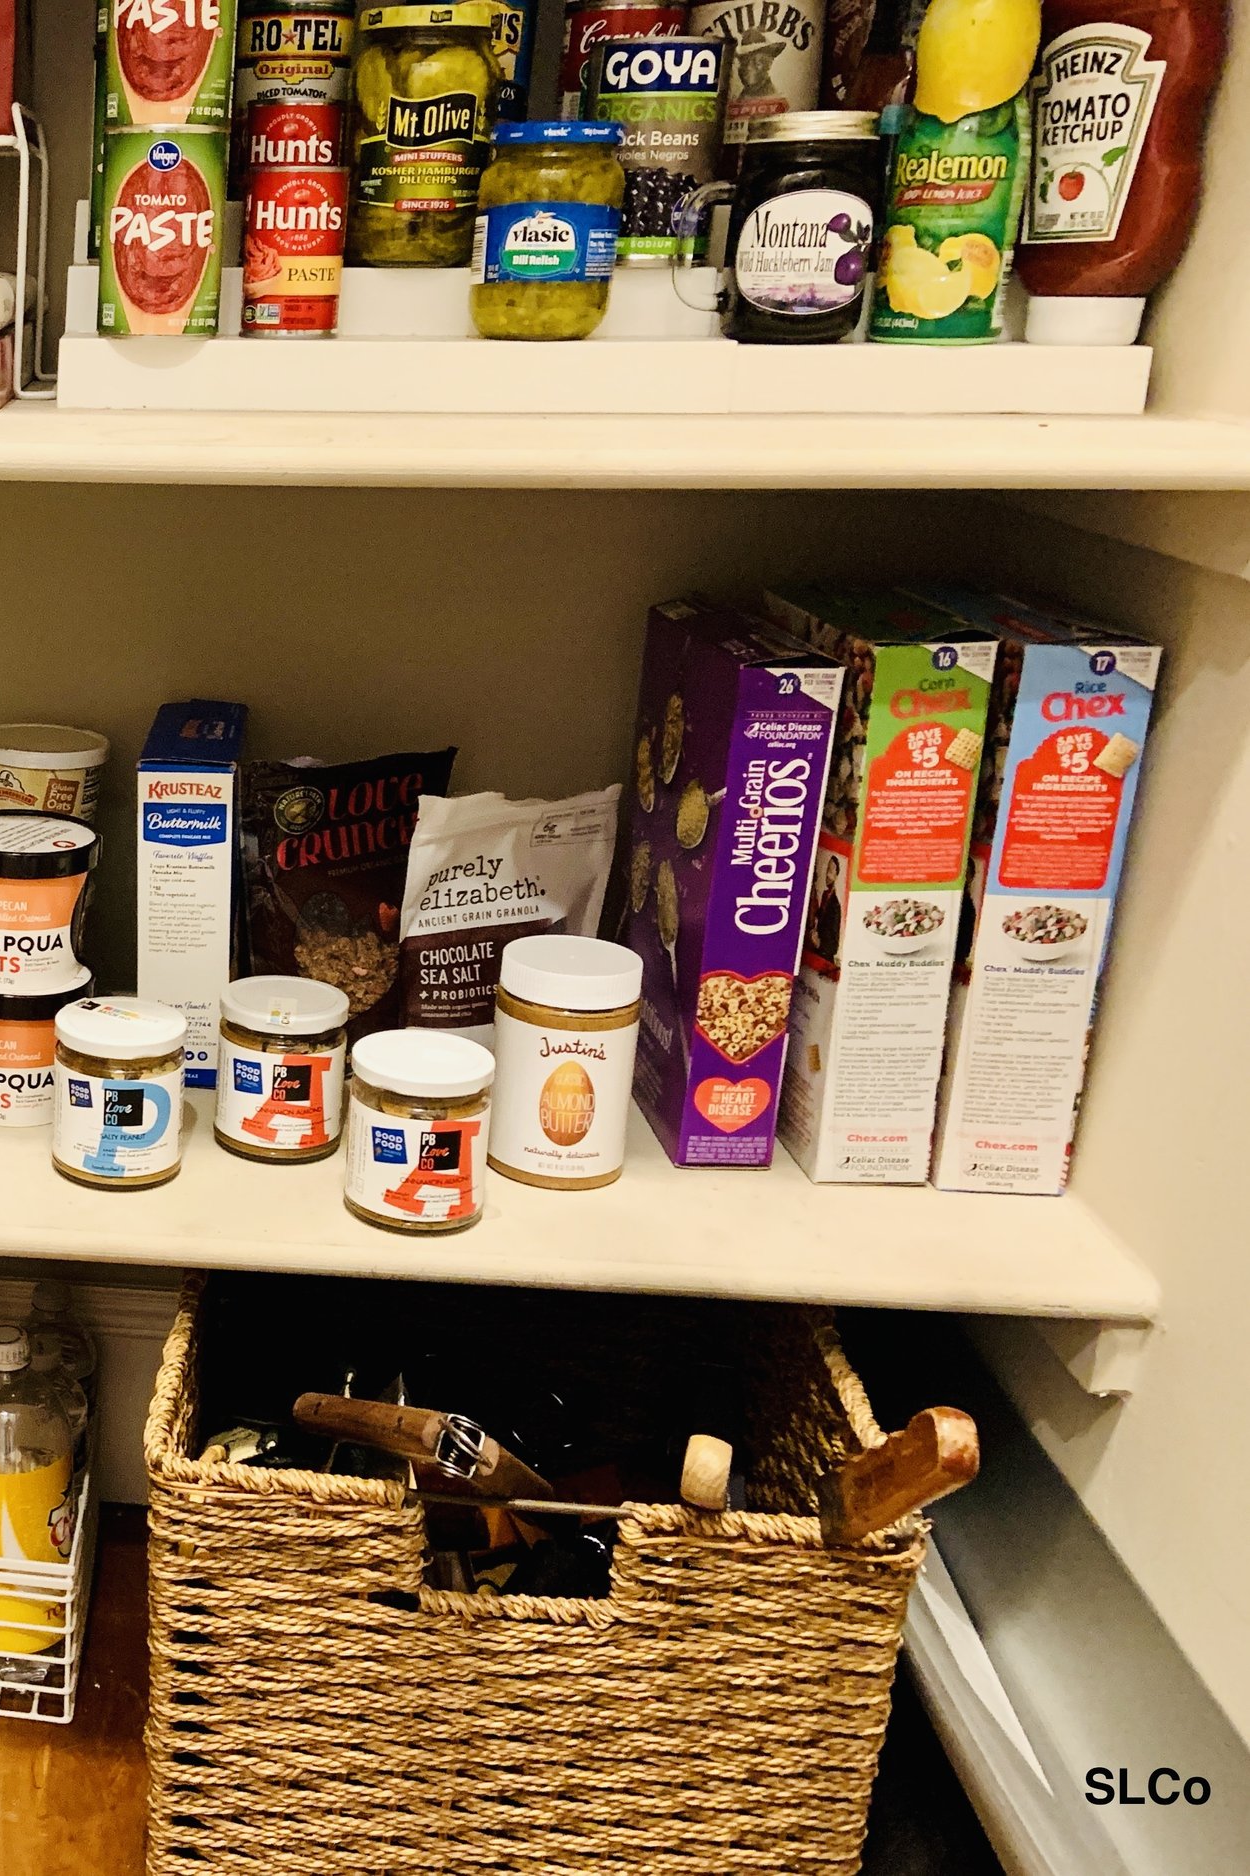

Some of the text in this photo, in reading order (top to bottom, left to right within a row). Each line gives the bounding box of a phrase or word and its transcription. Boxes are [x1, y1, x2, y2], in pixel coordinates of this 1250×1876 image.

[113, 0, 219, 33] PASTE
[258, 63, 330, 78] Original
[605, 49, 718, 89] GOYA
[1054, 52, 1124, 83] HEINZ
[598, 101, 717, 122] ORGANICS
[1041, 92, 1131, 123] TOMATO
[394, 102, 471, 139] Mt. Olive
[650, 131, 700, 147] Beans
[1040, 120, 1124, 147] KETCHUP
[151, 145, 179, 166] Kroger
[394, 152, 414, 163] MINI
[650, 150, 689, 162] Negros
[372, 167, 416, 177] KOSHER
[399, 175, 457, 185] DILL CHIPS
[134, 194, 187, 206] TOMATO
[402, 201, 428, 210] SINCE
[109, 207, 216, 251] PASTE
[512, 226, 570, 243] vlasic
[750, 210, 829, 248] Montana
[512, 255, 560, 265] Dill Relish
[813, 251, 834, 273] Jam
[287, 267, 335, 282] PASTE
[917, 677, 955, 692] Corn
[1074, 681, 1107, 694] Rice
[890, 688, 971, 720] Chex
[1041, 692, 1127, 722] Chex
[759, 721, 822, 732] Celiac Disease
[758, 731, 822, 741] FOUNDATION
[906, 728, 942, 742] SAVE
[1055, 733, 1093, 746] SAVE
[927, 737, 942, 747] TO
[1056, 742, 1093, 754] UP TO
[910, 747, 940, 768] $5
[1060, 752, 1090, 774] $5
[915, 769, 952, 779] RECIPE
[1041, 775, 1102, 785] ON RECIPE
[51, 783, 76, 792] Gluten
[886, 777, 958, 787] INGREDIENTS
[1032, 782, 1107, 793] INGREDIENTS
[49, 790, 74, 801] Free
[148, 781, 222, 799] KRUSTEAZ
[46, 799, 72, 811] Oats
[146, 813, 222, 830] Buttermilk
[731, 818, 757, 866] Multi
[734, 758, 811, 935] Cheerios
[425, 855, 503, 892] purely
[417, 905, 540, 928] ANCIENT GRAIN GRANOLA
[419, 941, 495, 966] CHOCOLATE
[848, 959, 945, 968] Chex Muddy Buddies
[420, 964, 481, 985] SEA SALT
[984, 965, 1086, 976] Chex Muddy Buddies
[539, 1036, 607, 1061] Justin's
[236, 1062, 260, 1075] GOOD
[273, 1066, 287, 1077] PB
[236, 1070, 260, 1082] FOOD
[70, 1084, 90, 1094] GOOD
[274, 1078, 300, 1089] Love
[70, 1090, 90, 1100] FOOD
[105, 1091, 118, 1102] PB
[273, 1089, 286, 1100] CO
[541, 1091, 594, 1110] ALMOND
[721, 1092, 756, 1104] HEART
[106, 1102, 133, 1114] Love
[708, 1104, 753, 1115] DISEASE
[105, 1114, 118, 1125] CO
[540, 1109, 594, 1133] BUTTER
[374, 1131, 403, 1143] GOOD
[421, 1133, 436, 1146] PB
[846, 1134, 908, 1142] Chex.com
[374, 1138, 403, 1151] FOOD
[975, 1140, 1038, 1151] Chex.com
[421, 1145, 450, 1157] Love
[566, 1151, 600, 1159] delicious
[1006, 1165, 1039, 1173] Disease
[400, 1177, 443, 1185] CINNAMON
